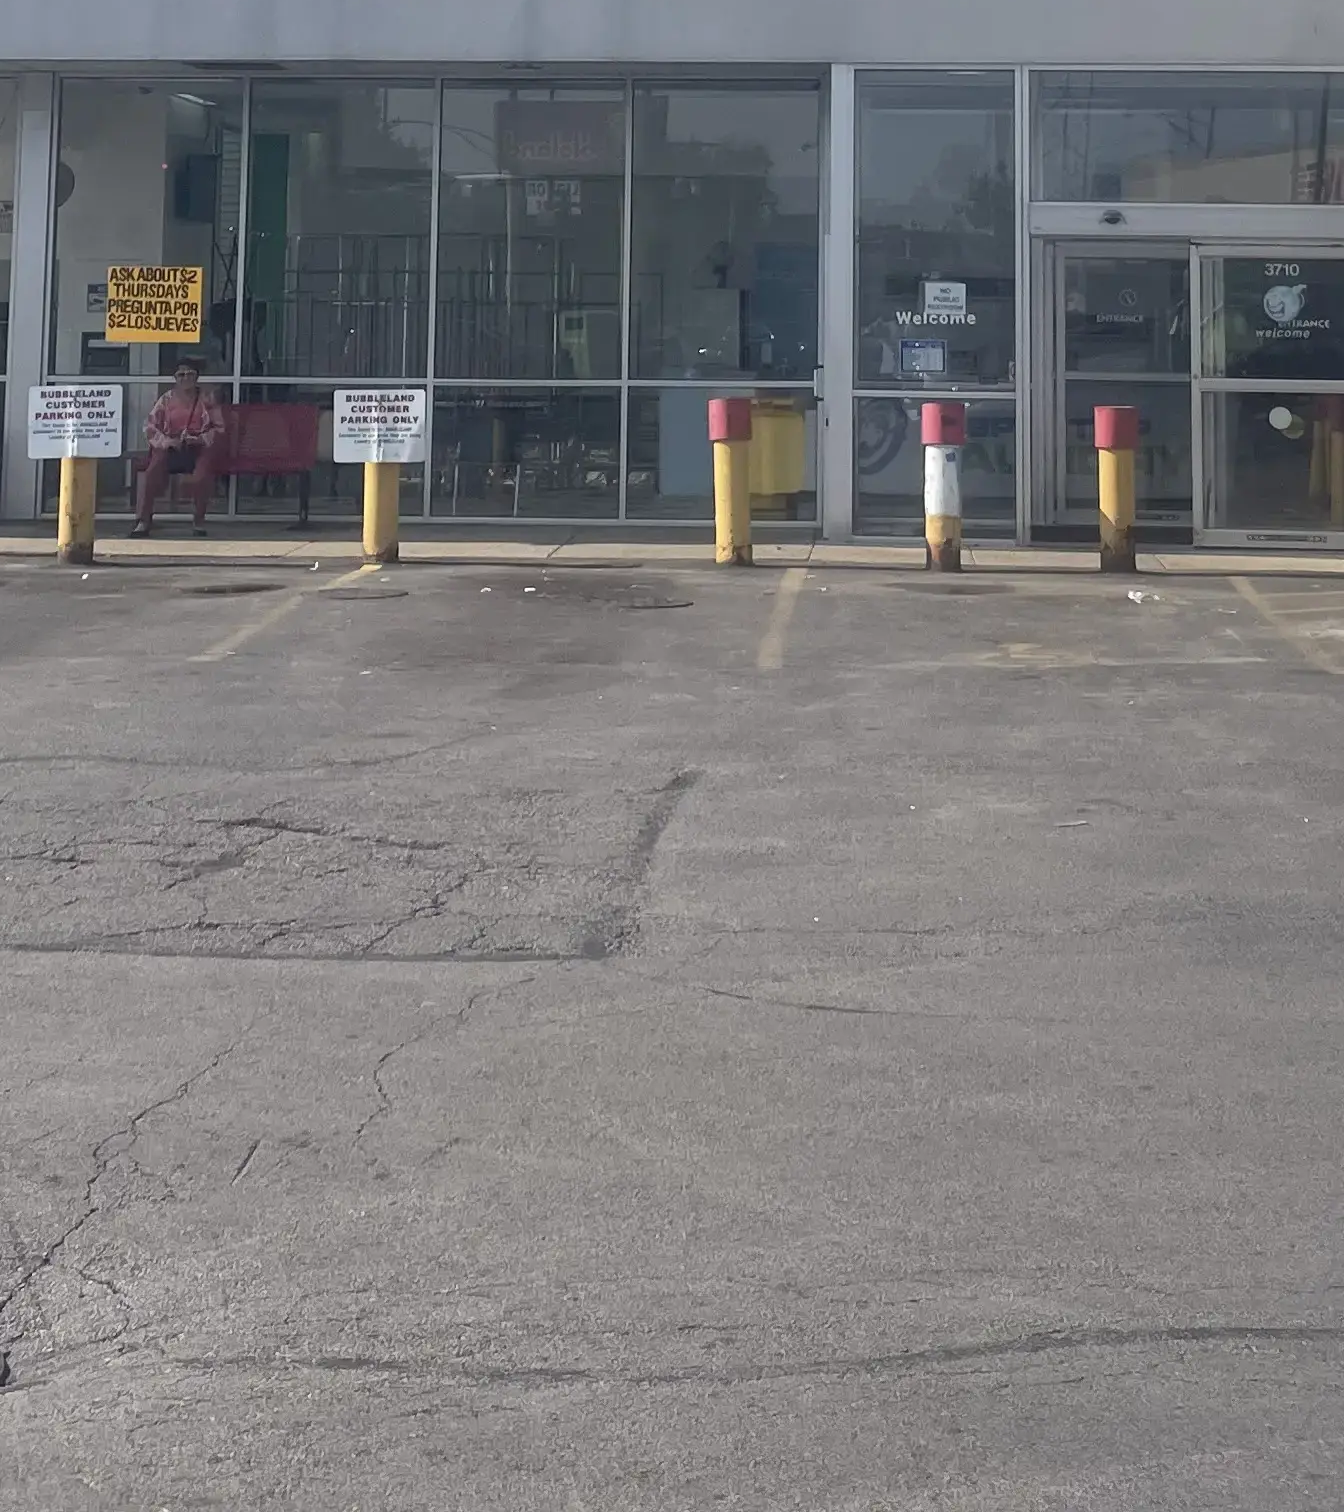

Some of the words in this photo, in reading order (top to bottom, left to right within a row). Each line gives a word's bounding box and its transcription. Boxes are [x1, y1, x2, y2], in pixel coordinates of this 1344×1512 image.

[1264, 263, 1300, 277] 3710
[109, 268, 136, 283] ASK
[136, 268, 179, 283] ABOUT
[179, 268, 198, 284] $2
[113, 283, 189, 299] THURSDAYS
[108, 298, 173, 316] PREGUNTA
[173, 301, 199, 316] POR
[108, 312, 127, 329] $2
[127, 314, 152, 330] LOS
[150, 316, 200, 332] JUEVES
[896, 311, 977, 326] Welcome
[1256, 328, 1311, 339] welcome
[40, 389, 112, 399] BUBBLELAND
[345, 394, 416, 403] BUBBLELAND
[45, 400, 106, 409] CUSTOMER
[351, 405, 410, 413] CUSTOMER
[35, 411, 83, 420] PARKING
[87, 410, 116, 419] ONLY
[340, 416, 388, 424] PARKING
[392, 416, 420, 424] ONLY
